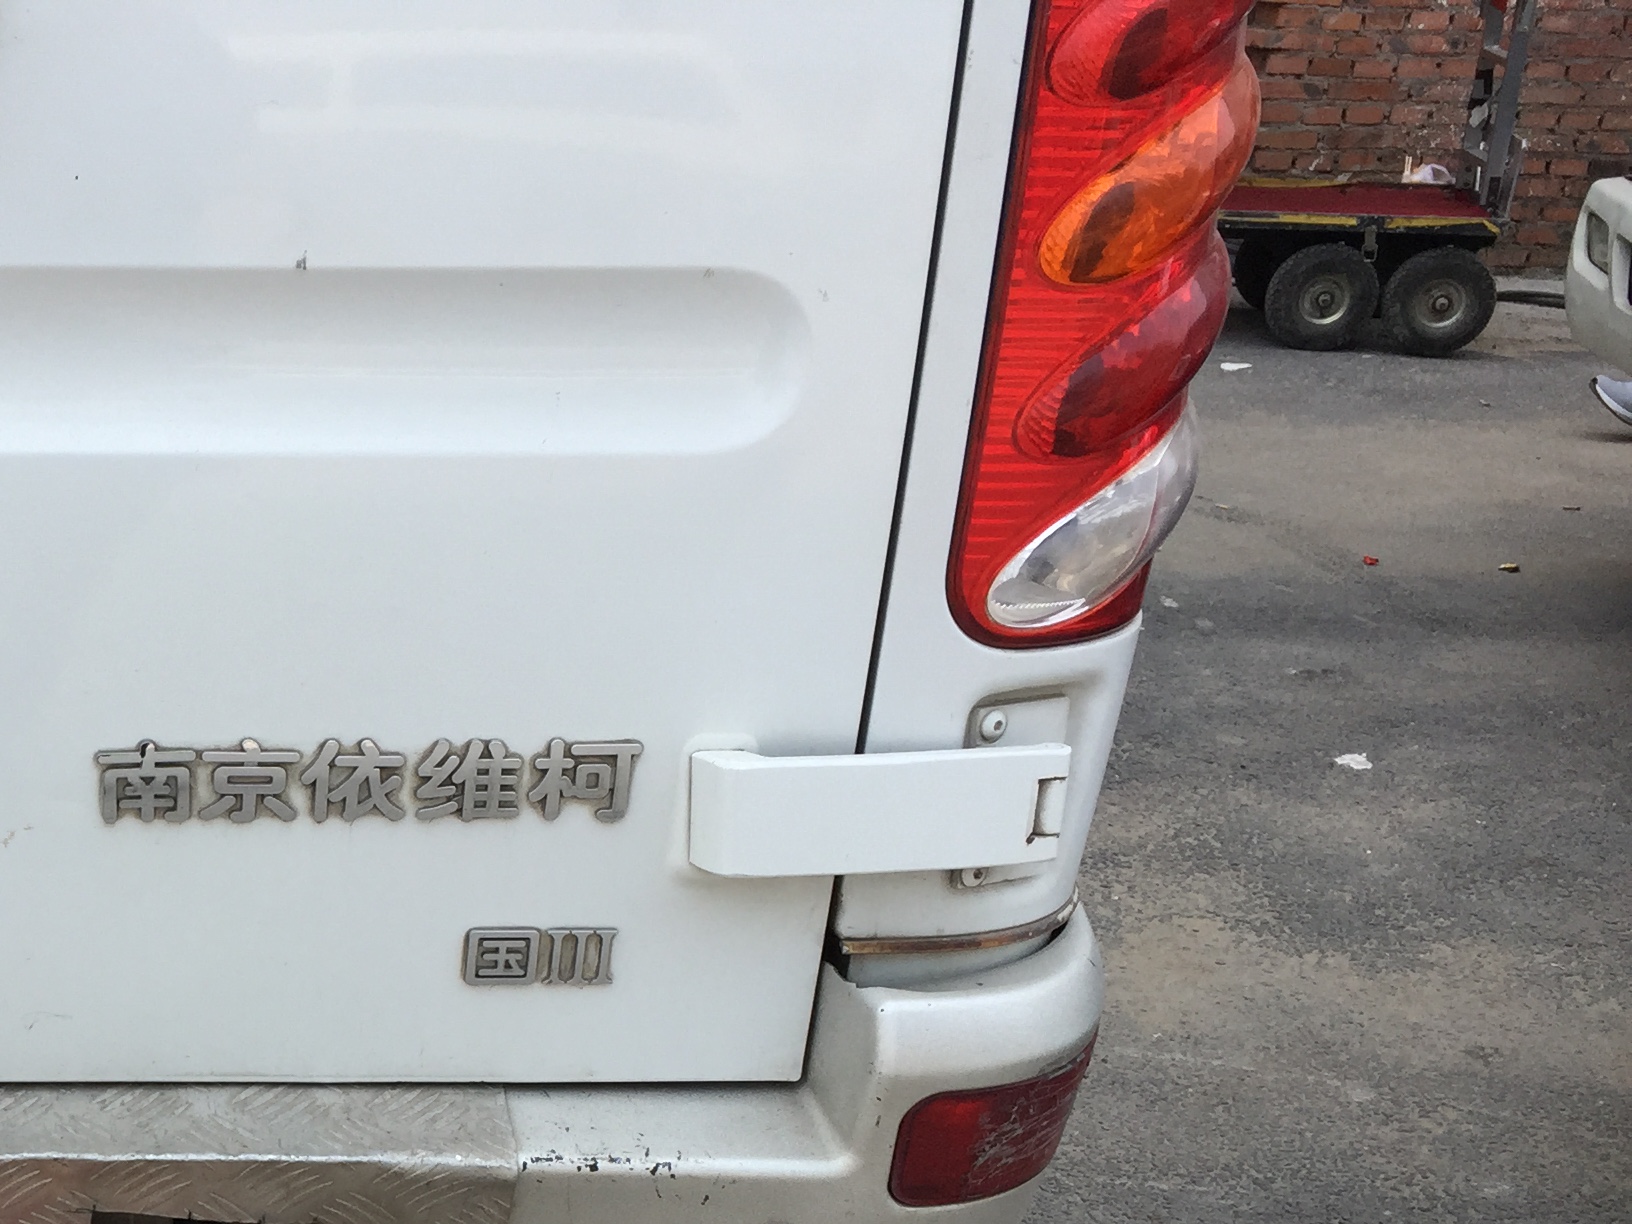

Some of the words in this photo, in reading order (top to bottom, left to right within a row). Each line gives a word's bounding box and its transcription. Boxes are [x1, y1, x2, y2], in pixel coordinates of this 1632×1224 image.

[94, 738, 644, 825] 南京依维柯
